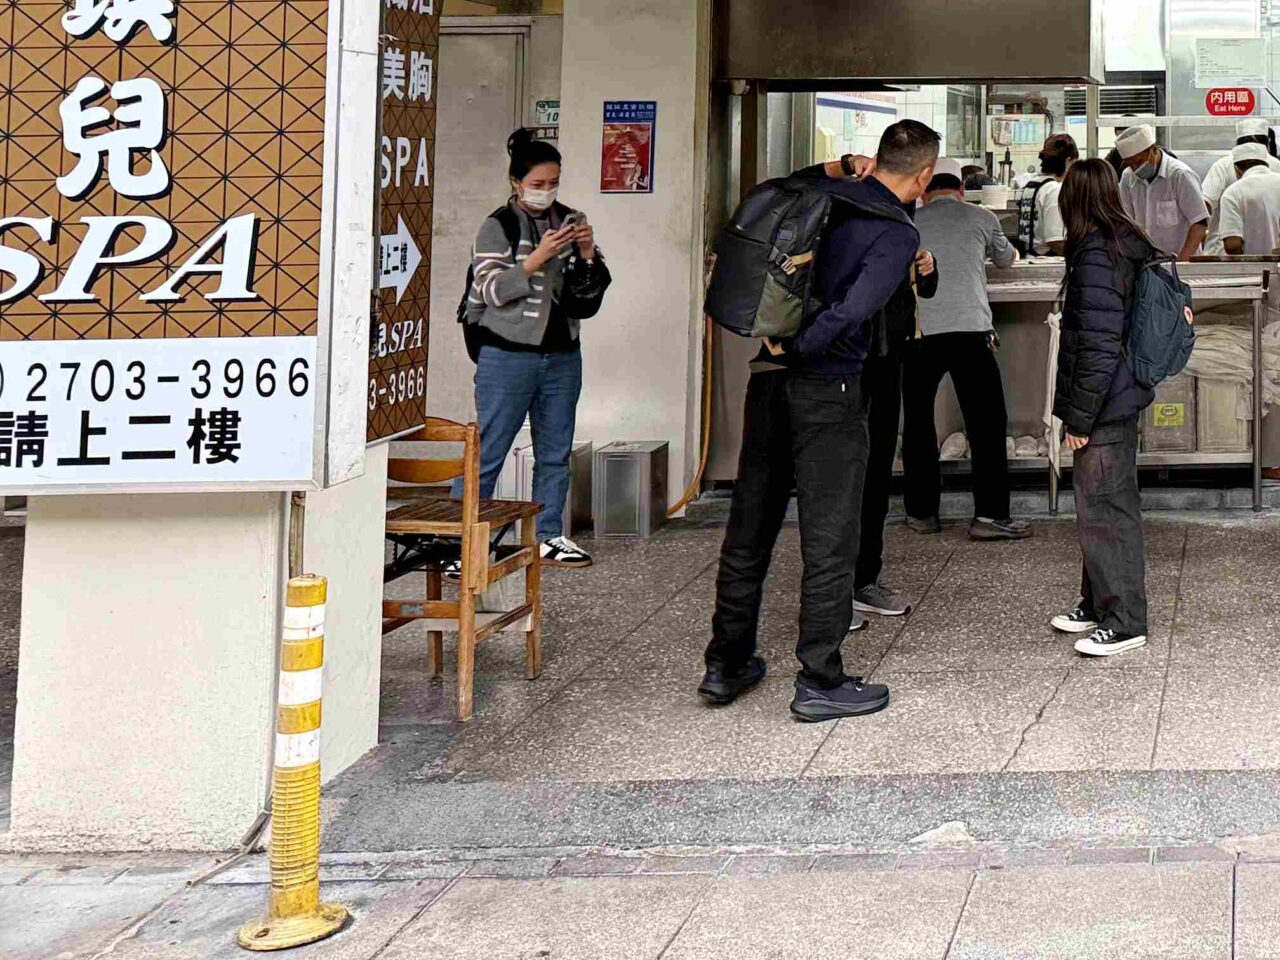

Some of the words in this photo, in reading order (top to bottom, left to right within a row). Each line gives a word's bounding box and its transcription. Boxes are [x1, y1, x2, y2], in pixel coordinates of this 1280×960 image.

[383, 46, 433, 103] 美胸
[1214, 104, 1227, 112] Eat
[1228, 104, 1246, 112] Here
[381, 135, 429, 189] SPA
[0, 212, 259, 303] SPA
[379, 242, 408, 276] 上二樓
[0, 407, 242, 469] 請上二樓
